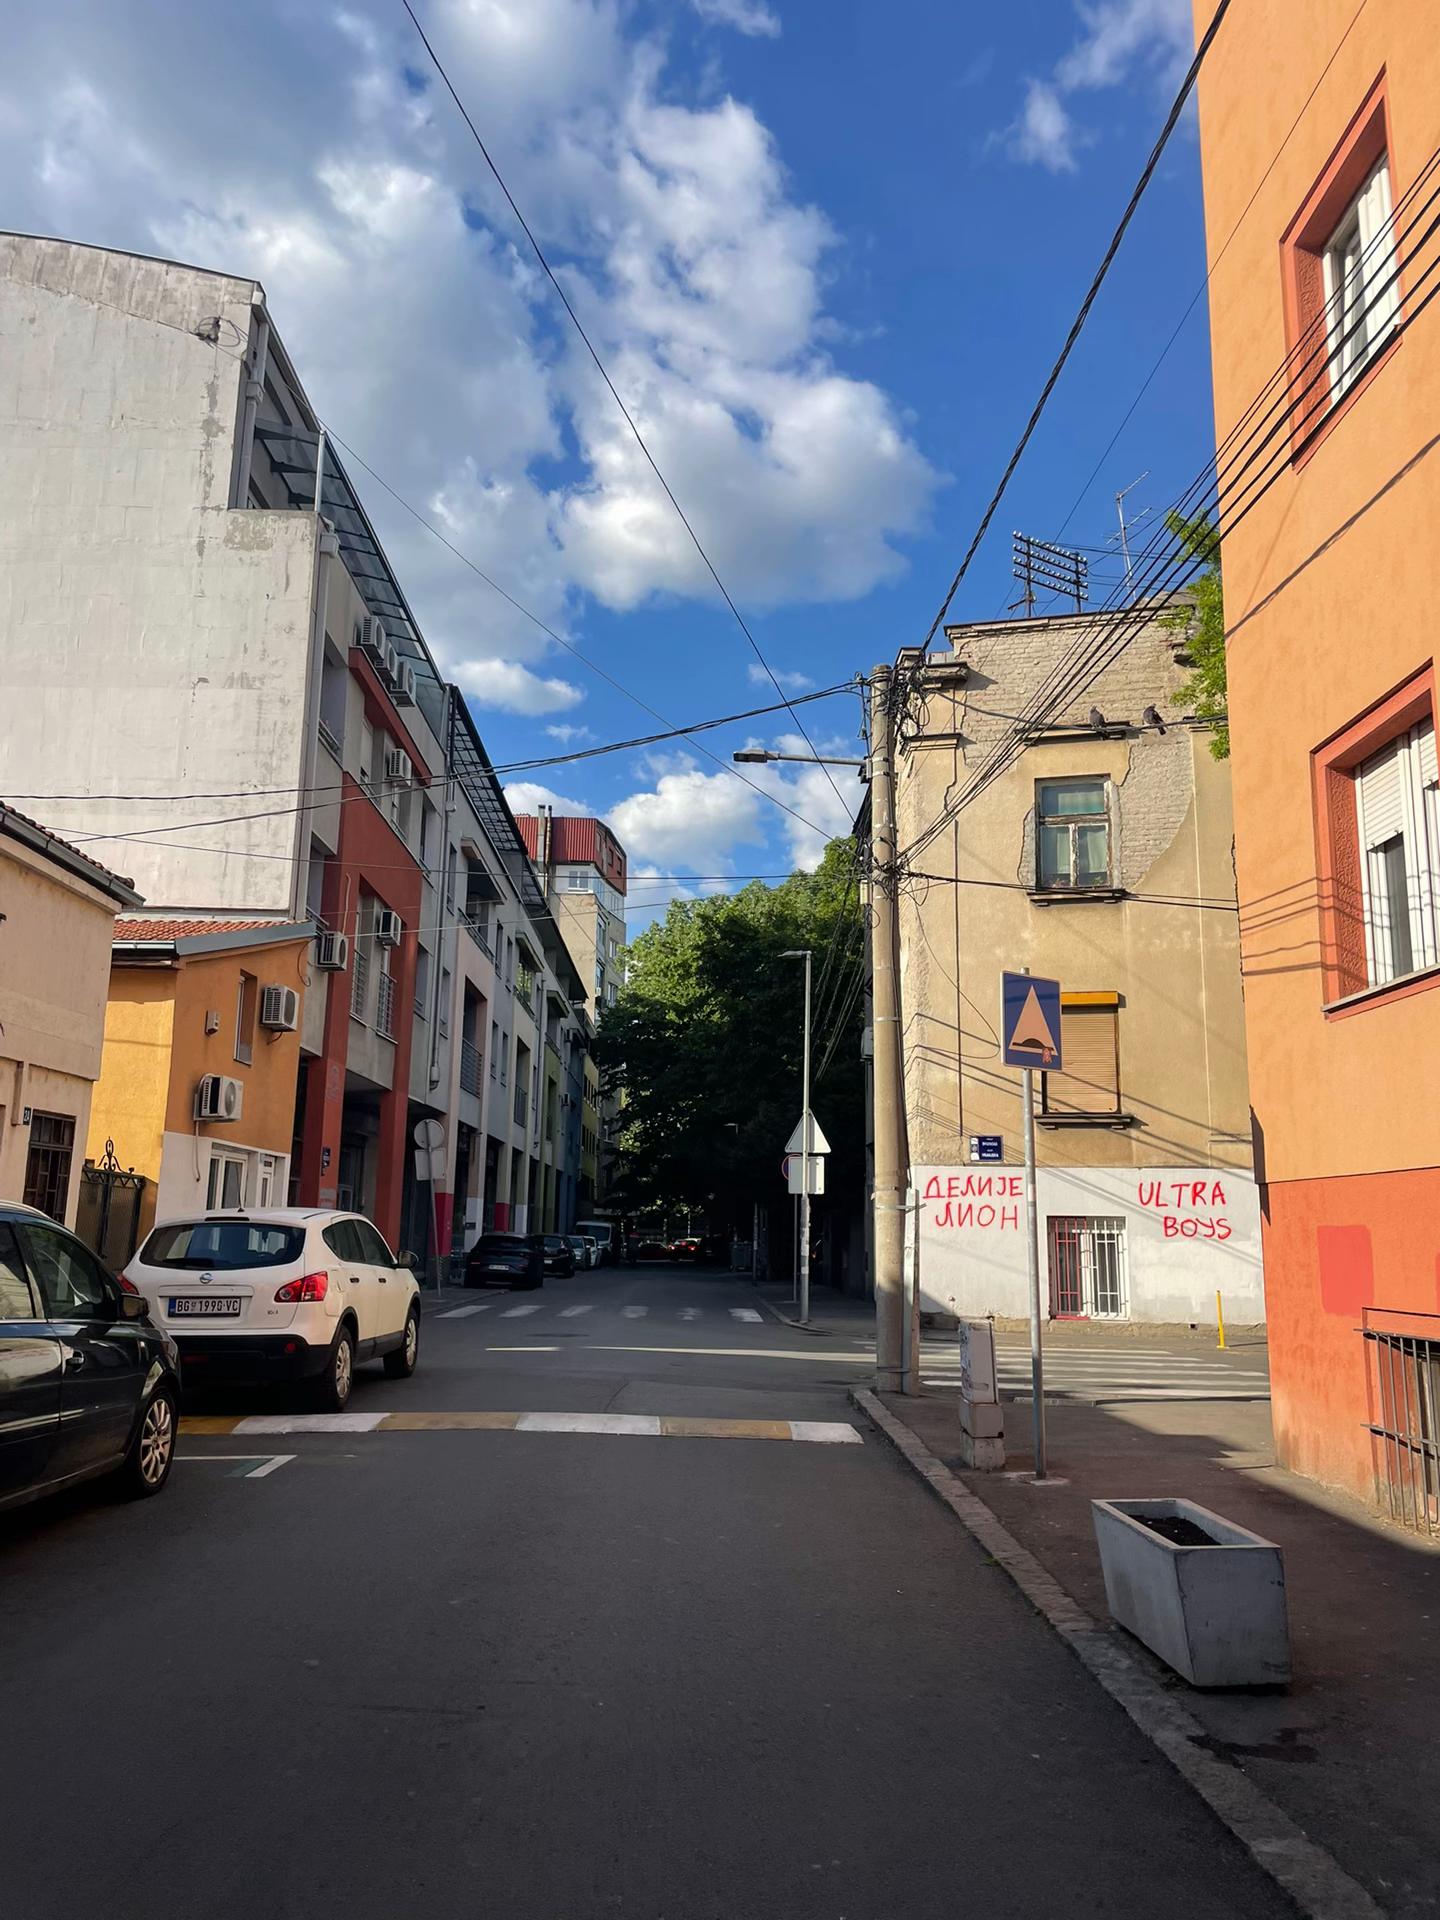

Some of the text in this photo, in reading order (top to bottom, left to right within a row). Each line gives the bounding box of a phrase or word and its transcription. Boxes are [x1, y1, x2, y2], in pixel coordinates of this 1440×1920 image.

[923, 1174, 1024, 1200] ДЕЛИЈЕ
[1138, 1180, 1228, 1210] ULTRA
[935, 1202, 1019, 1232] ЛИОН
[1163, 1214, 1233, 1243] BOYS
[176, 1300, 190, 1313] BG
